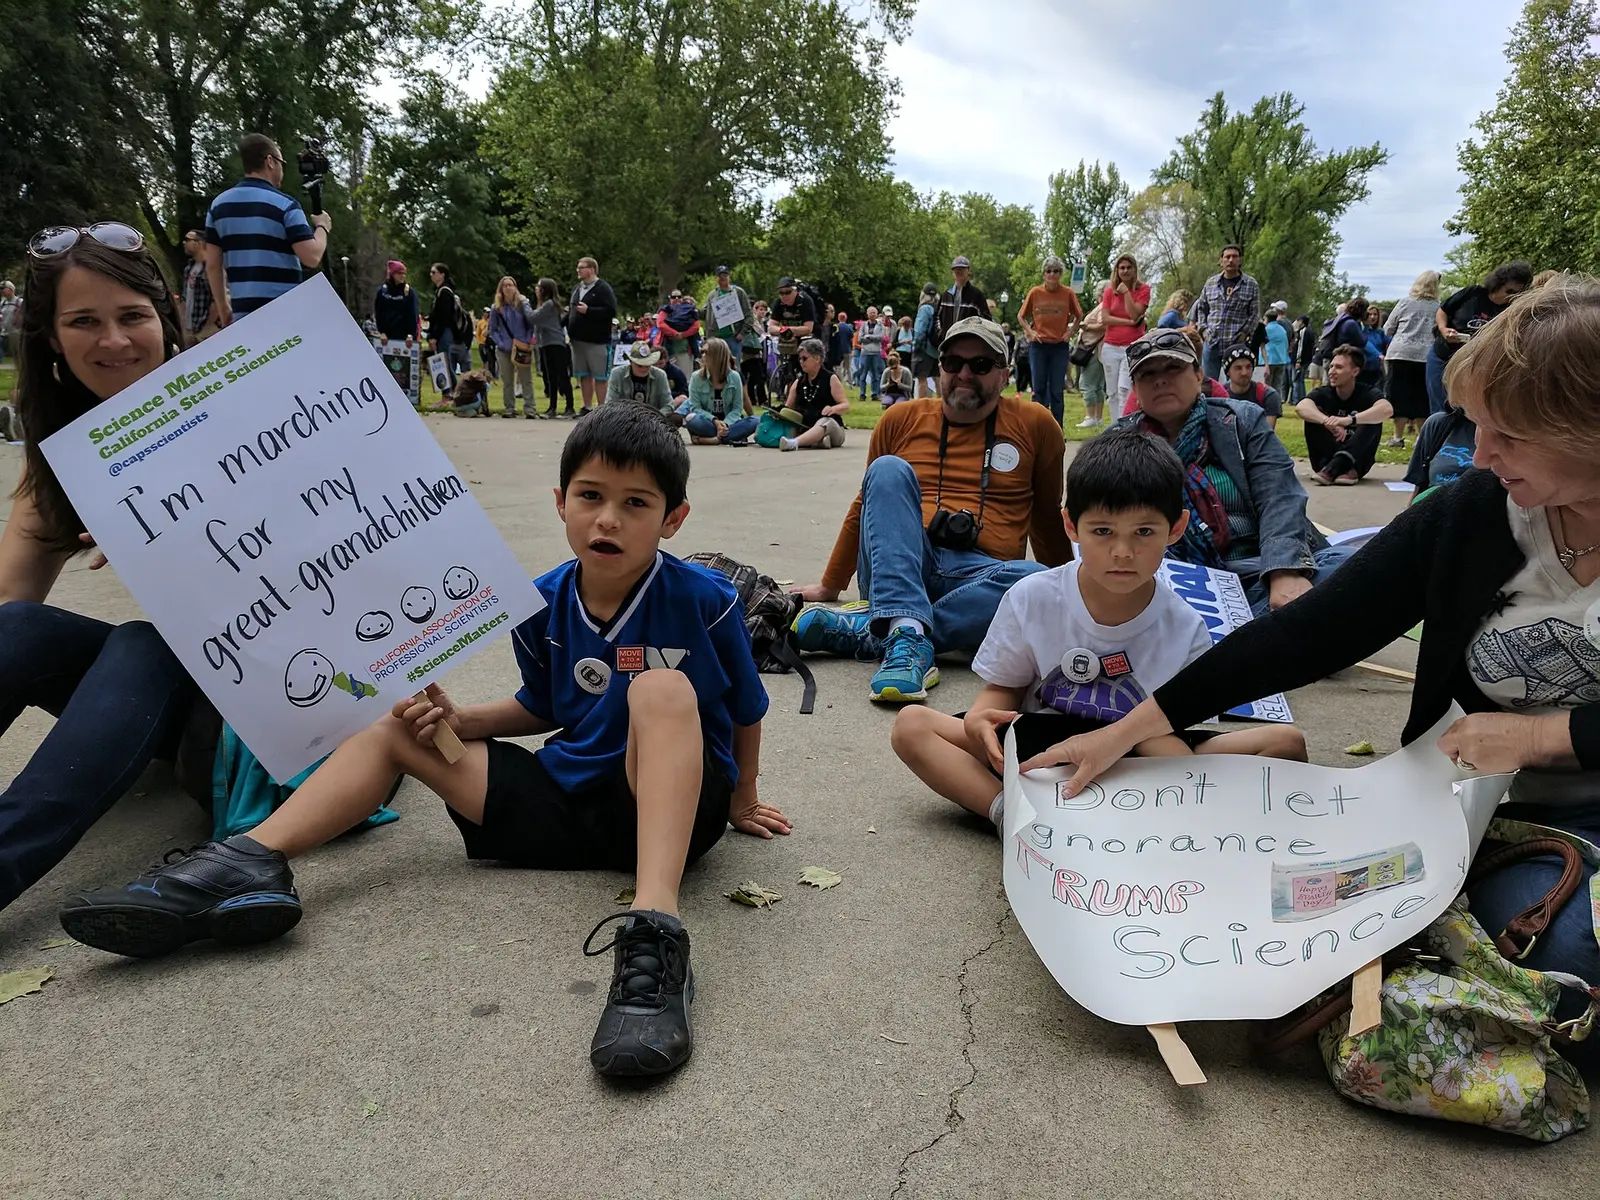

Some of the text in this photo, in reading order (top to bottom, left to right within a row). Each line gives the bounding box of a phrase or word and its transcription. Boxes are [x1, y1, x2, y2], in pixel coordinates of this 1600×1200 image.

[88, 344, 251, 445] Science Matters.
[98, 334, 302, 459] California State Scientists
[108, 410, 209, 477] @capsscientists
[117, 376, 390, 545] I'm marching
[205, 467, 362, 573] for my
[369, 586, 494, 673] CALIFORNIA ASSOCIATION OF
[374, 594, 500, 682] PROFESSIONAL SCIENTISTS
[406, 611, 509, 683] #ScienceMatters
[1104, 655, 1123, 665] MOVE
[1055, 766, 1362, 818] Don't let
[1015, 833, 1205, 917] TRUMP
[1031, 822, 1327, 856] gnorance
[1113, 892, 1439, 980] Science
